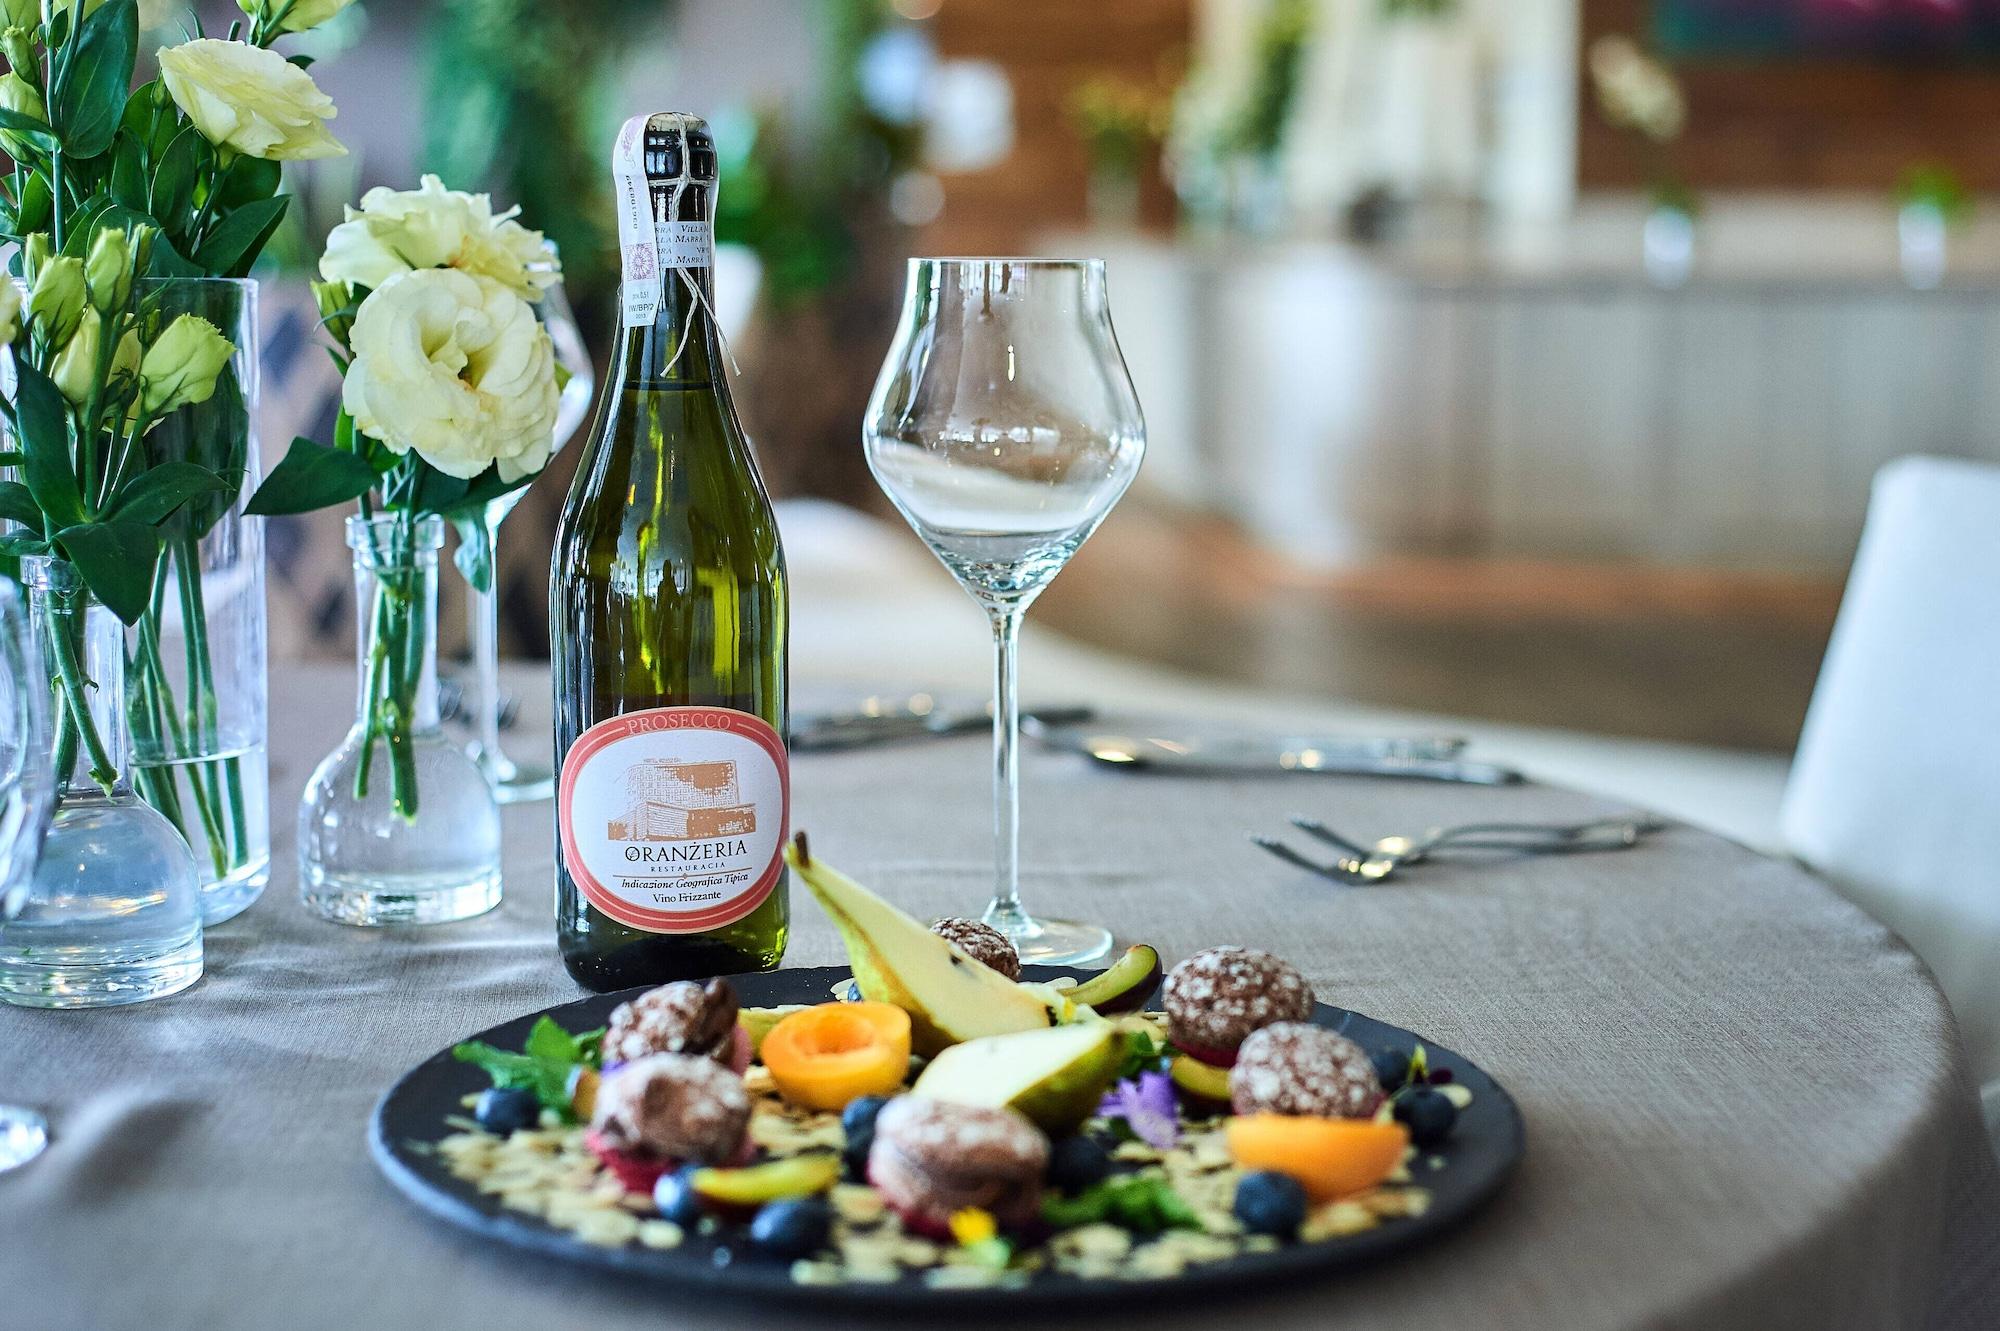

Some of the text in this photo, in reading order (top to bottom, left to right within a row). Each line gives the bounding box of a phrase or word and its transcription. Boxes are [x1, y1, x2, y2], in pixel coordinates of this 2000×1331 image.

[627, 713, 731, 735] PROSECCO
[625, 840, 747, 862] ORANŻERIA
[621, 873, 748, 889] Indicazione Geografica Tipica
[653, 891, 721, 903] Vino Frizzante
